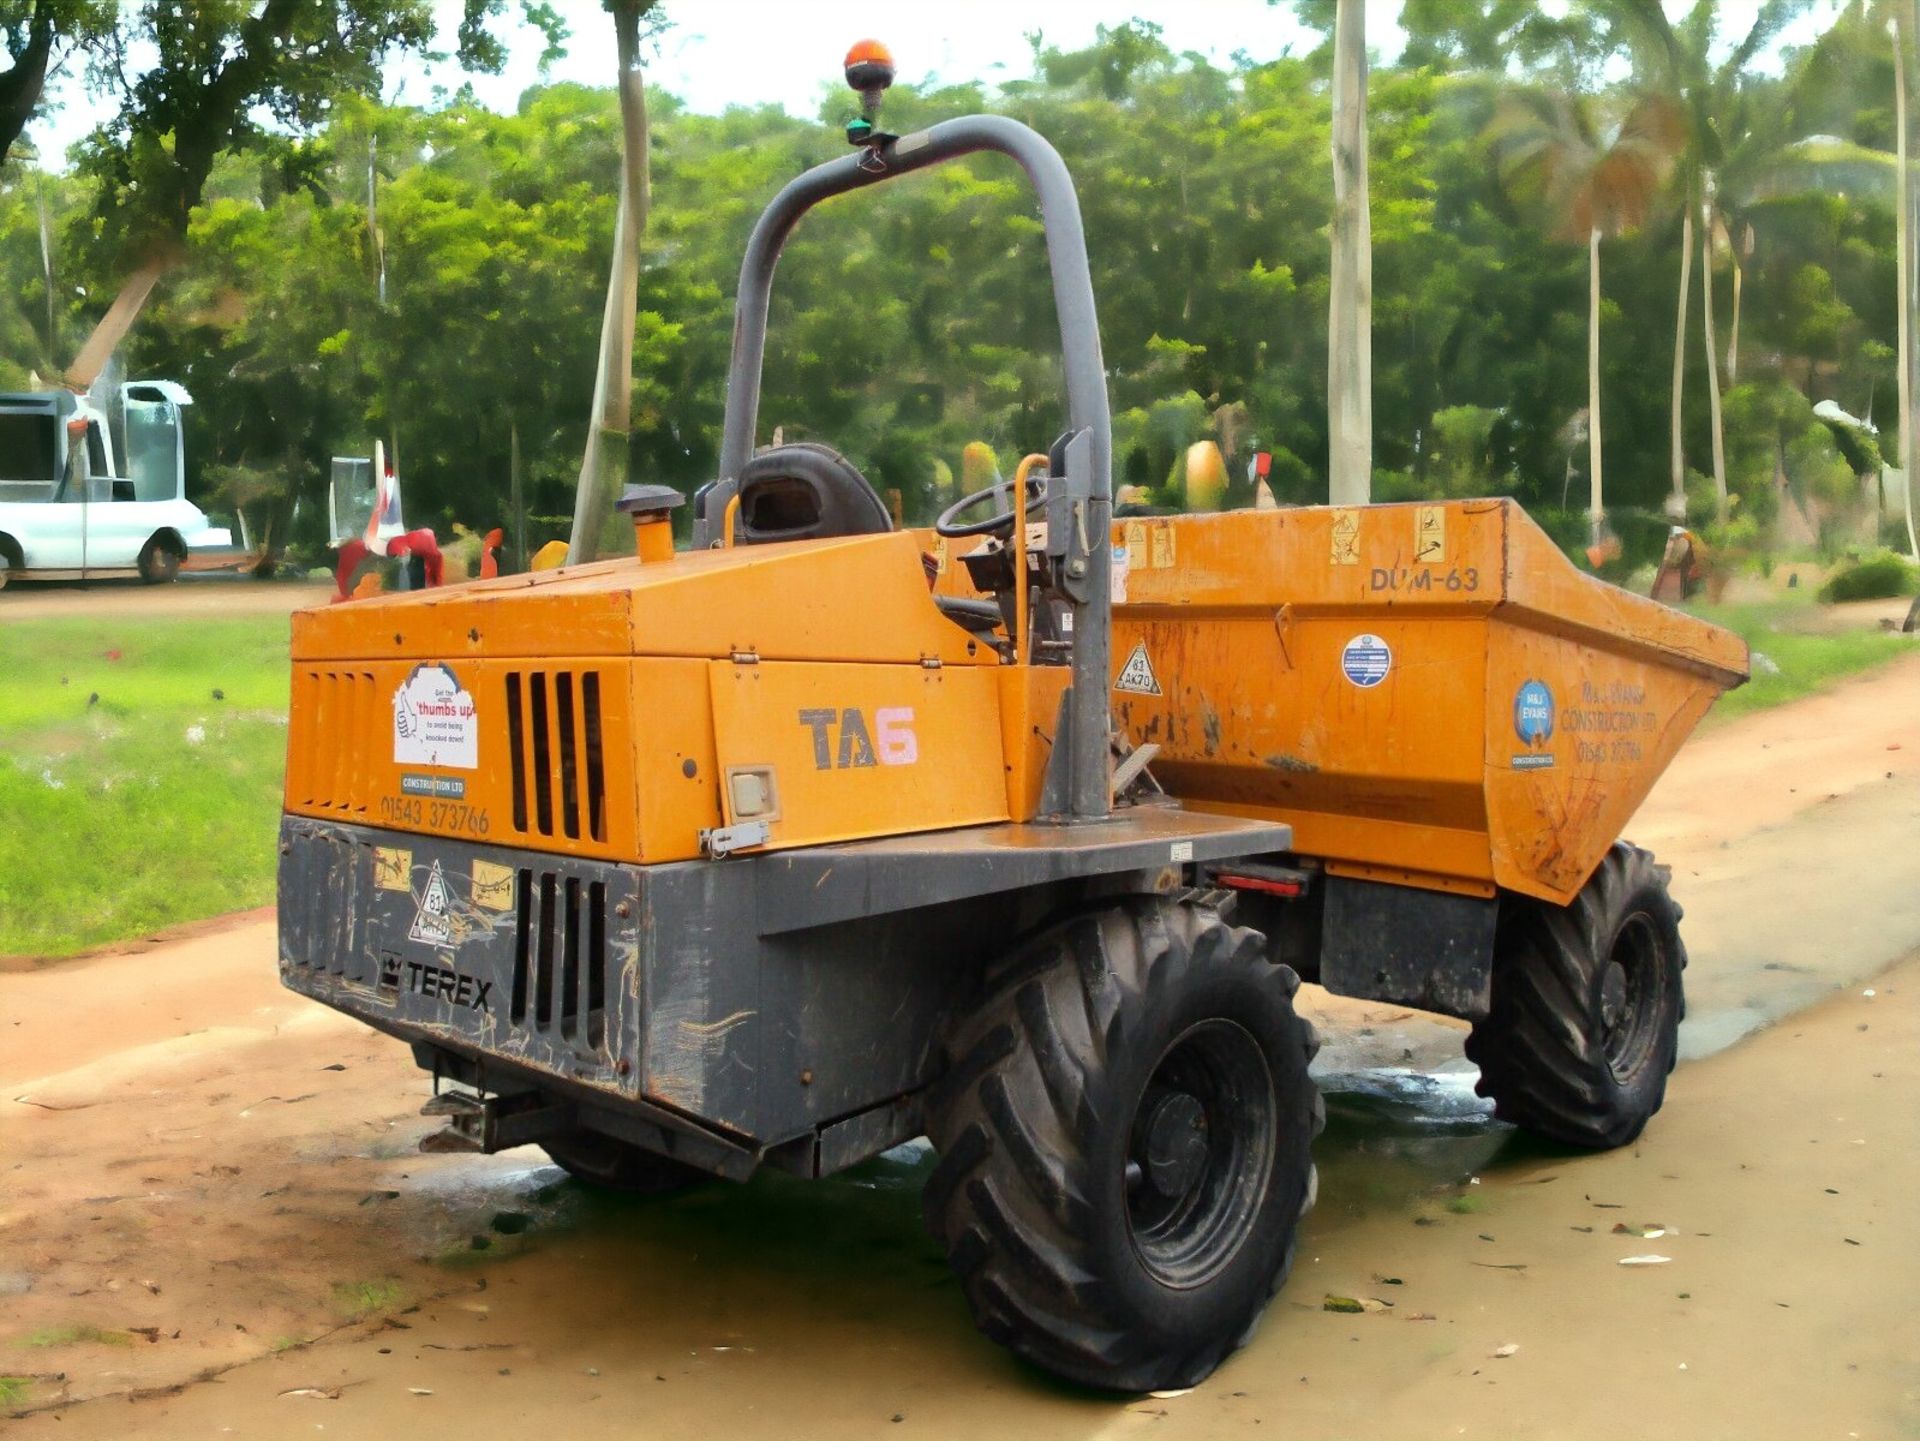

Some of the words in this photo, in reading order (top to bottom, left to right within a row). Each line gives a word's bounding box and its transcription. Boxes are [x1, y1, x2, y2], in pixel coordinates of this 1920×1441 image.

[1371, 567, 1479, 593] DUM-63
[1124, 672, 1150, 688] AK70
[1522, 706, 1547, 719] EVANS
[798, 706, 919, 771] TA6
[403, 778, 450, 791] CONSTRUTION
[451, 781, 464, 792] LTD
[380, 796, 422, 825] 01543
[429, 801, 490, 834] 373766
[407, 961, 493, 1013] TEREX
